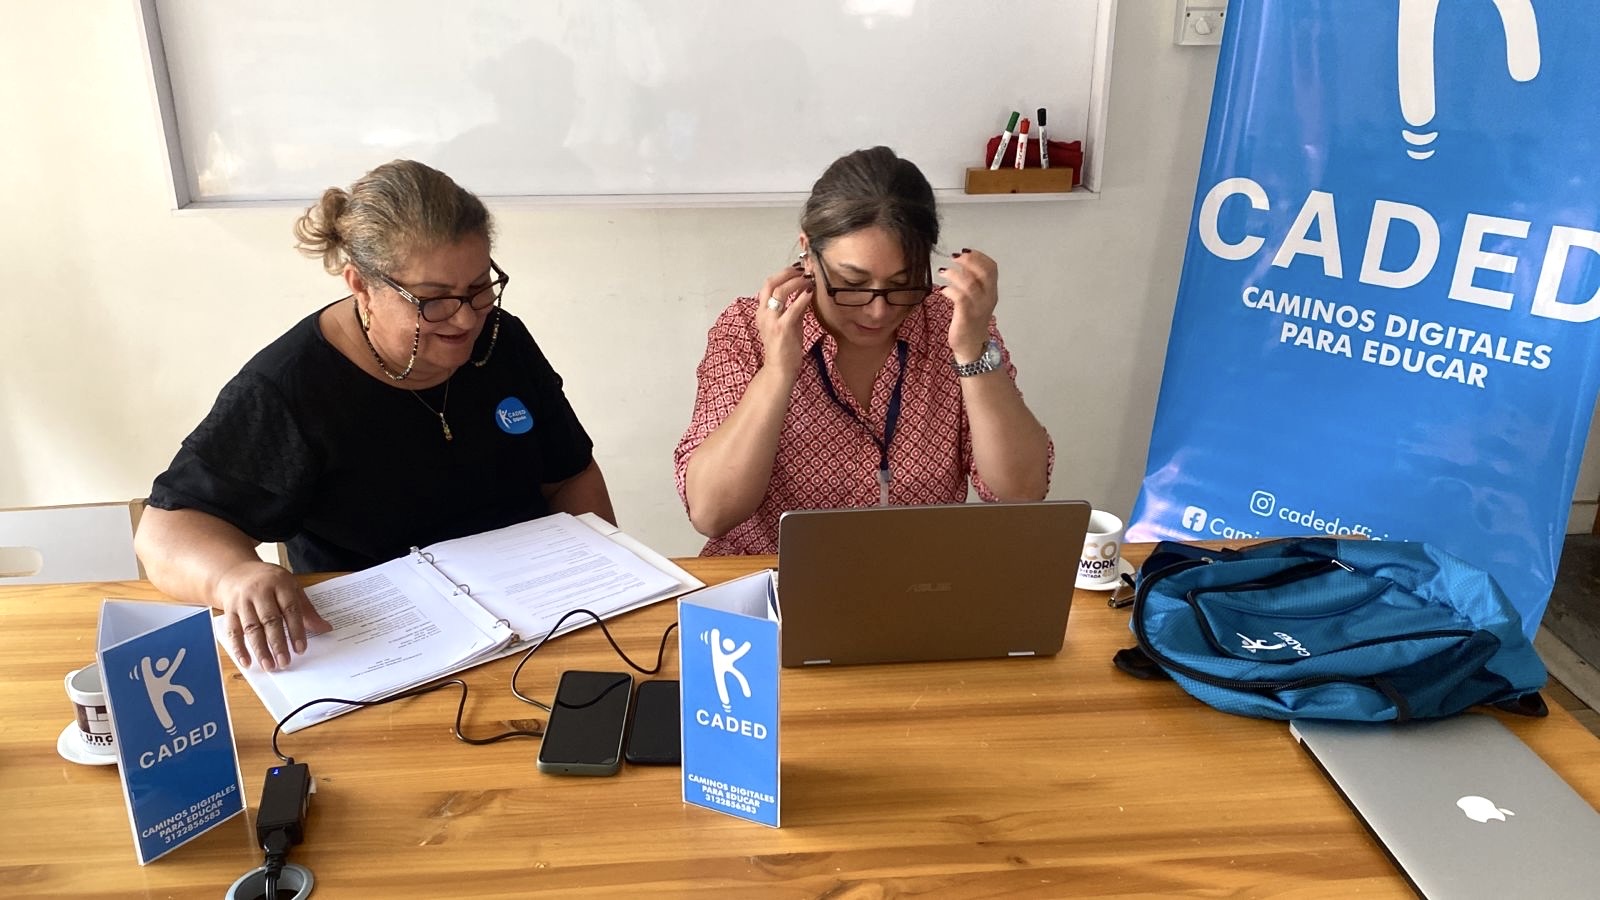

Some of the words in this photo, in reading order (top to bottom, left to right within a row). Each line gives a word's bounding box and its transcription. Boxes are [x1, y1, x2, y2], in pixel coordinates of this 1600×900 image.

[1199, 177, 1600, 323] CADED
[1242, 286, 1376, 333] CAMINOS
[1384, 314, 1553, 370] DIGITALES
[1280, 321, 1353, 358] PARA
[1362, 339, 1489, 389] EDUCAR
[1080, 557, 1116, 570] WORK
[696, 709, 767, 740] CADED
[140, 721, 217, 769] CADED
[688, 773, 728, 791] CAMINOS
[730, 785, 775, 803] DIGITALES
[702, 785, 724, 797] PARA
[726, 791, 760, 808] EDUCAR
[705, 793, 757, 814] 3122856583
[142, 809, 188, 838] CAMINOS
[190, 784, 236, 813] DIGITALES
[160, 820, 185, 838] PARA
[187, 799, 224, 824] EDUCAR
[165, 809, 221, 844] 3122856583
